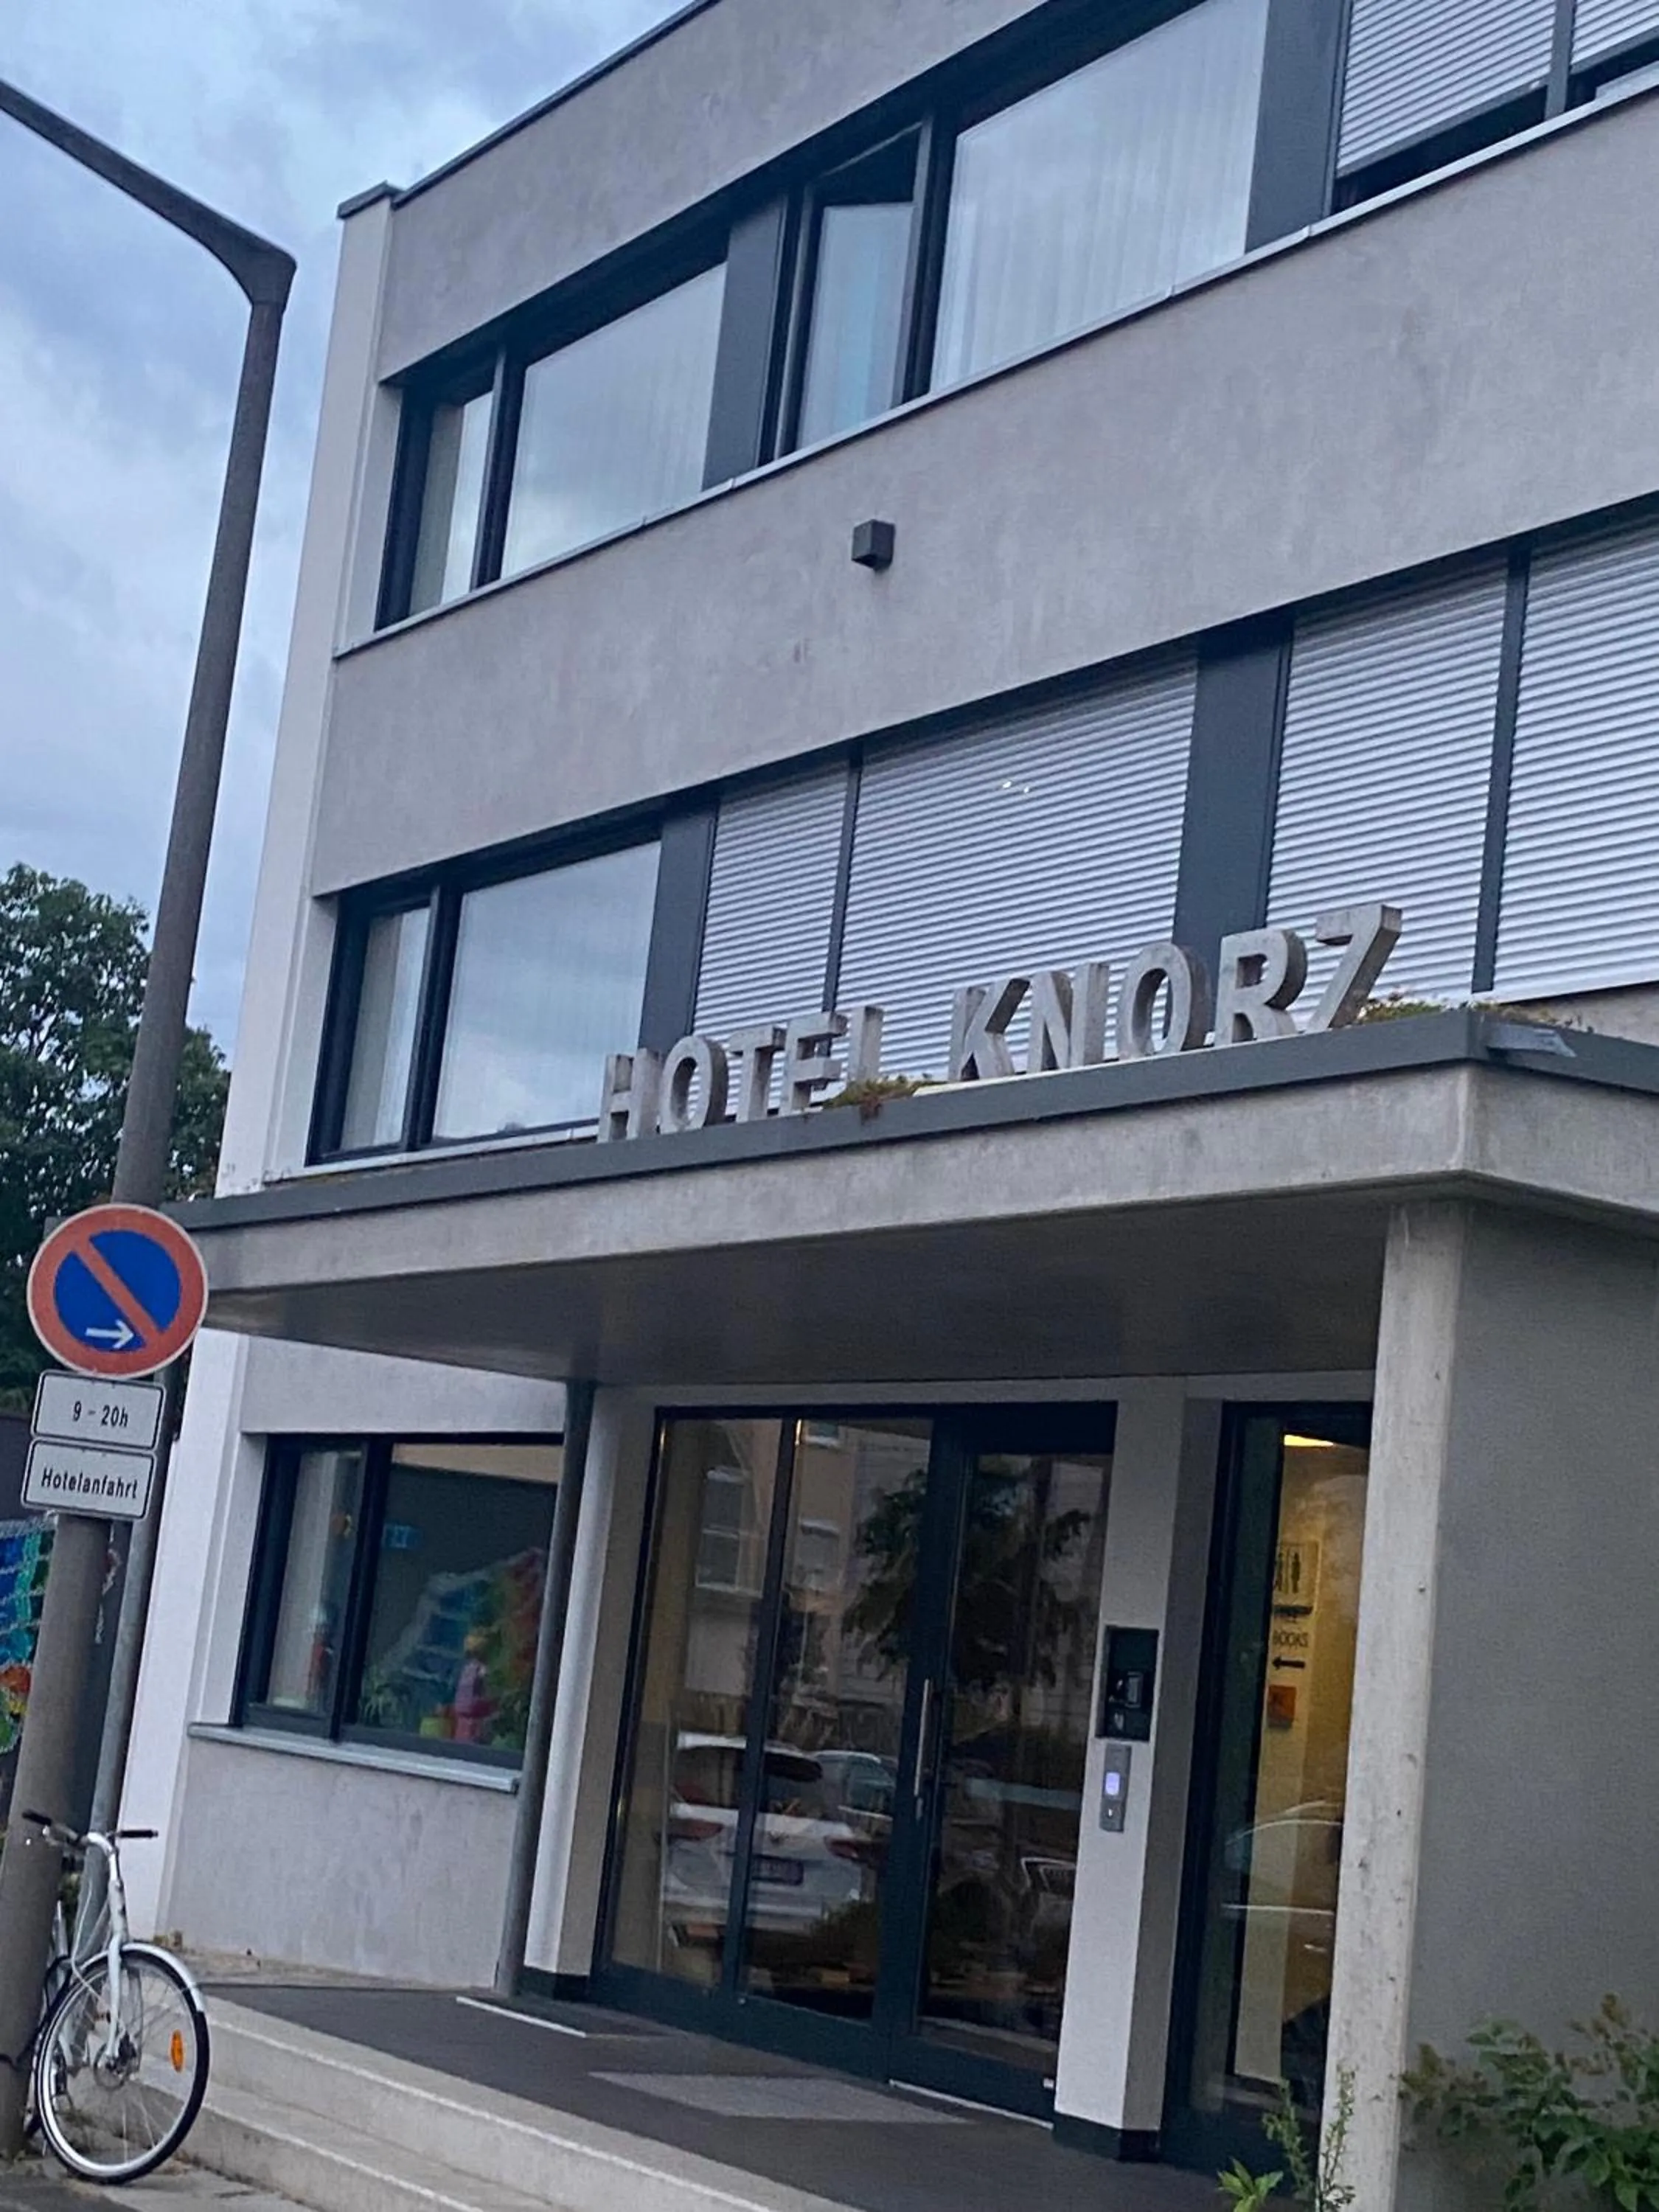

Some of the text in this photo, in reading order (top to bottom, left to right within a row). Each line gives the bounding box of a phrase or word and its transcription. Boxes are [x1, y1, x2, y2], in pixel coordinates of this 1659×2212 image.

[595, 904, 1402, 1143] HOTEL KNORZ
[72, 1400, 82, 1422] 9
[100, 1404, 129, 1428] 20h
[41, 1467, 138, 1500] Hotelanfahrt
